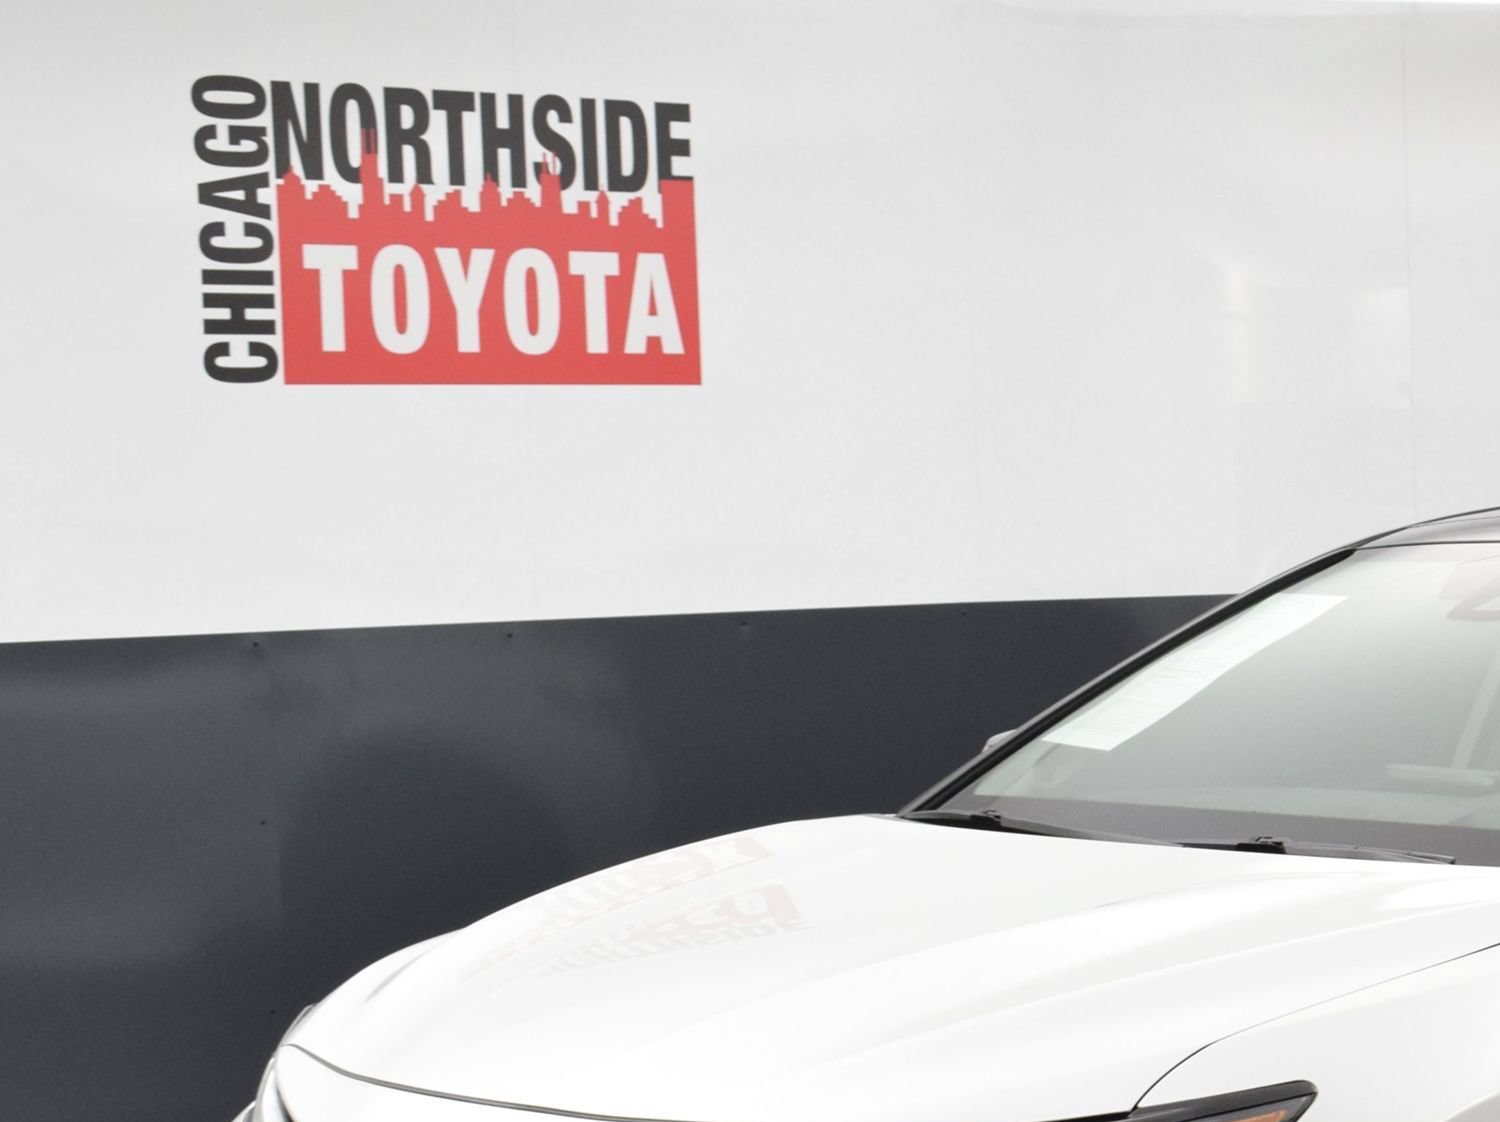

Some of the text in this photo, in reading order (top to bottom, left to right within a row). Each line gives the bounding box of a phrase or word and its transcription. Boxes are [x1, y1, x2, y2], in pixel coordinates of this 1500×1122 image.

[270, 80, 694, 193] NORTHSIDE
[191, 75, 279, 383] CHICAGO
[302, 244, 686, 355] TOYOTA
